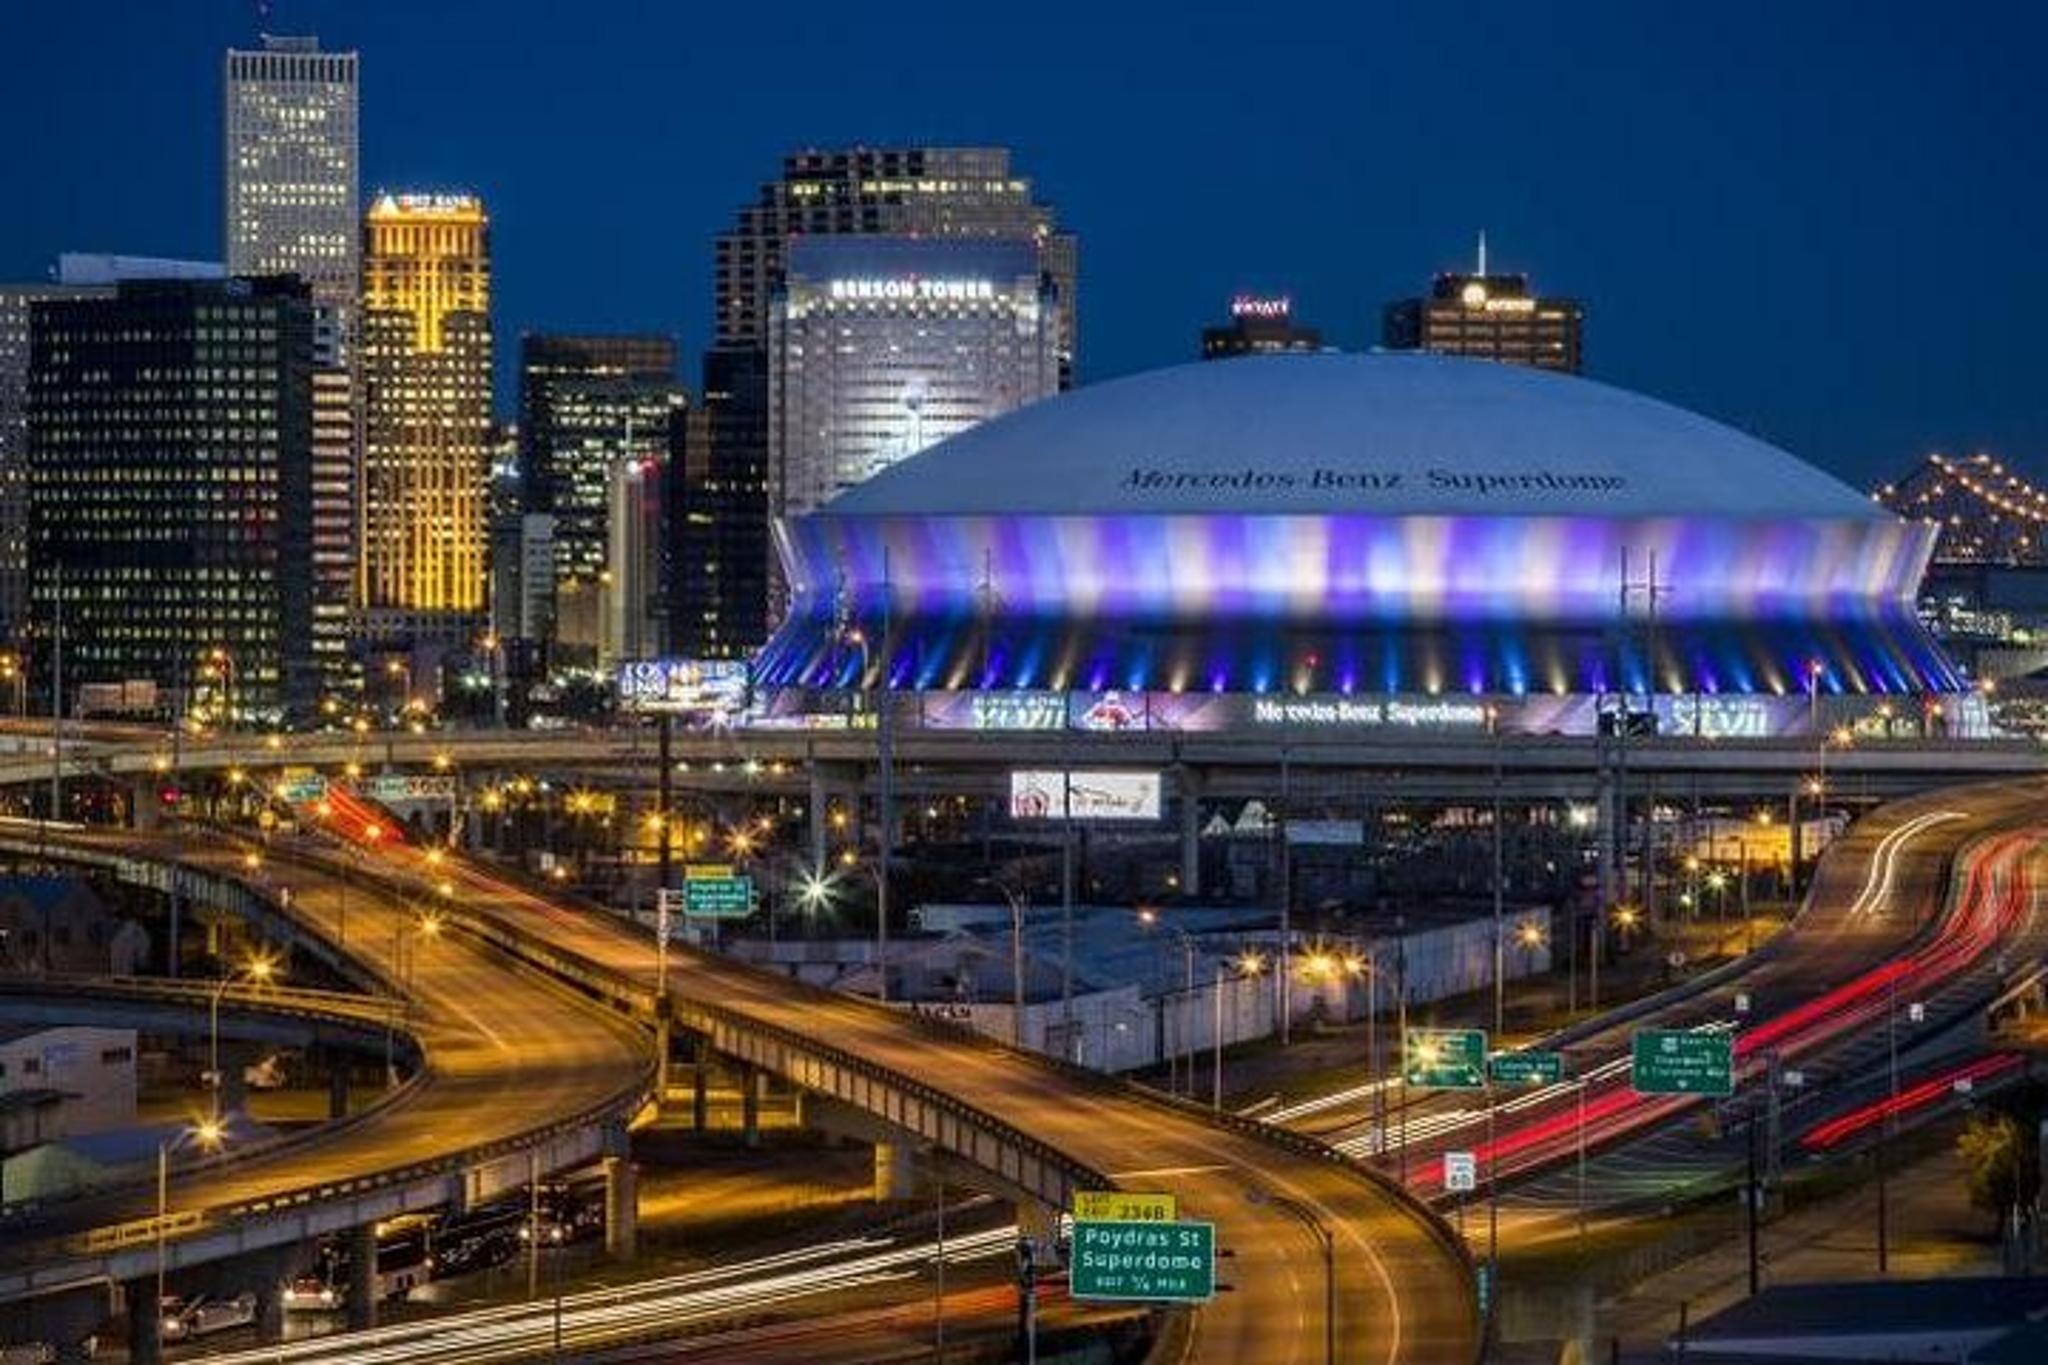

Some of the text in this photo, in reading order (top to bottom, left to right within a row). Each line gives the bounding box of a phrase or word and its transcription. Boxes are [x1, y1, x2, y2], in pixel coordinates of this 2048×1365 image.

[1427, 468, 1623, 494] Superdome
[1085, 1228, 1201, 1249] Poydras St
[1082, 1250, 1202, 1272] Superdome
